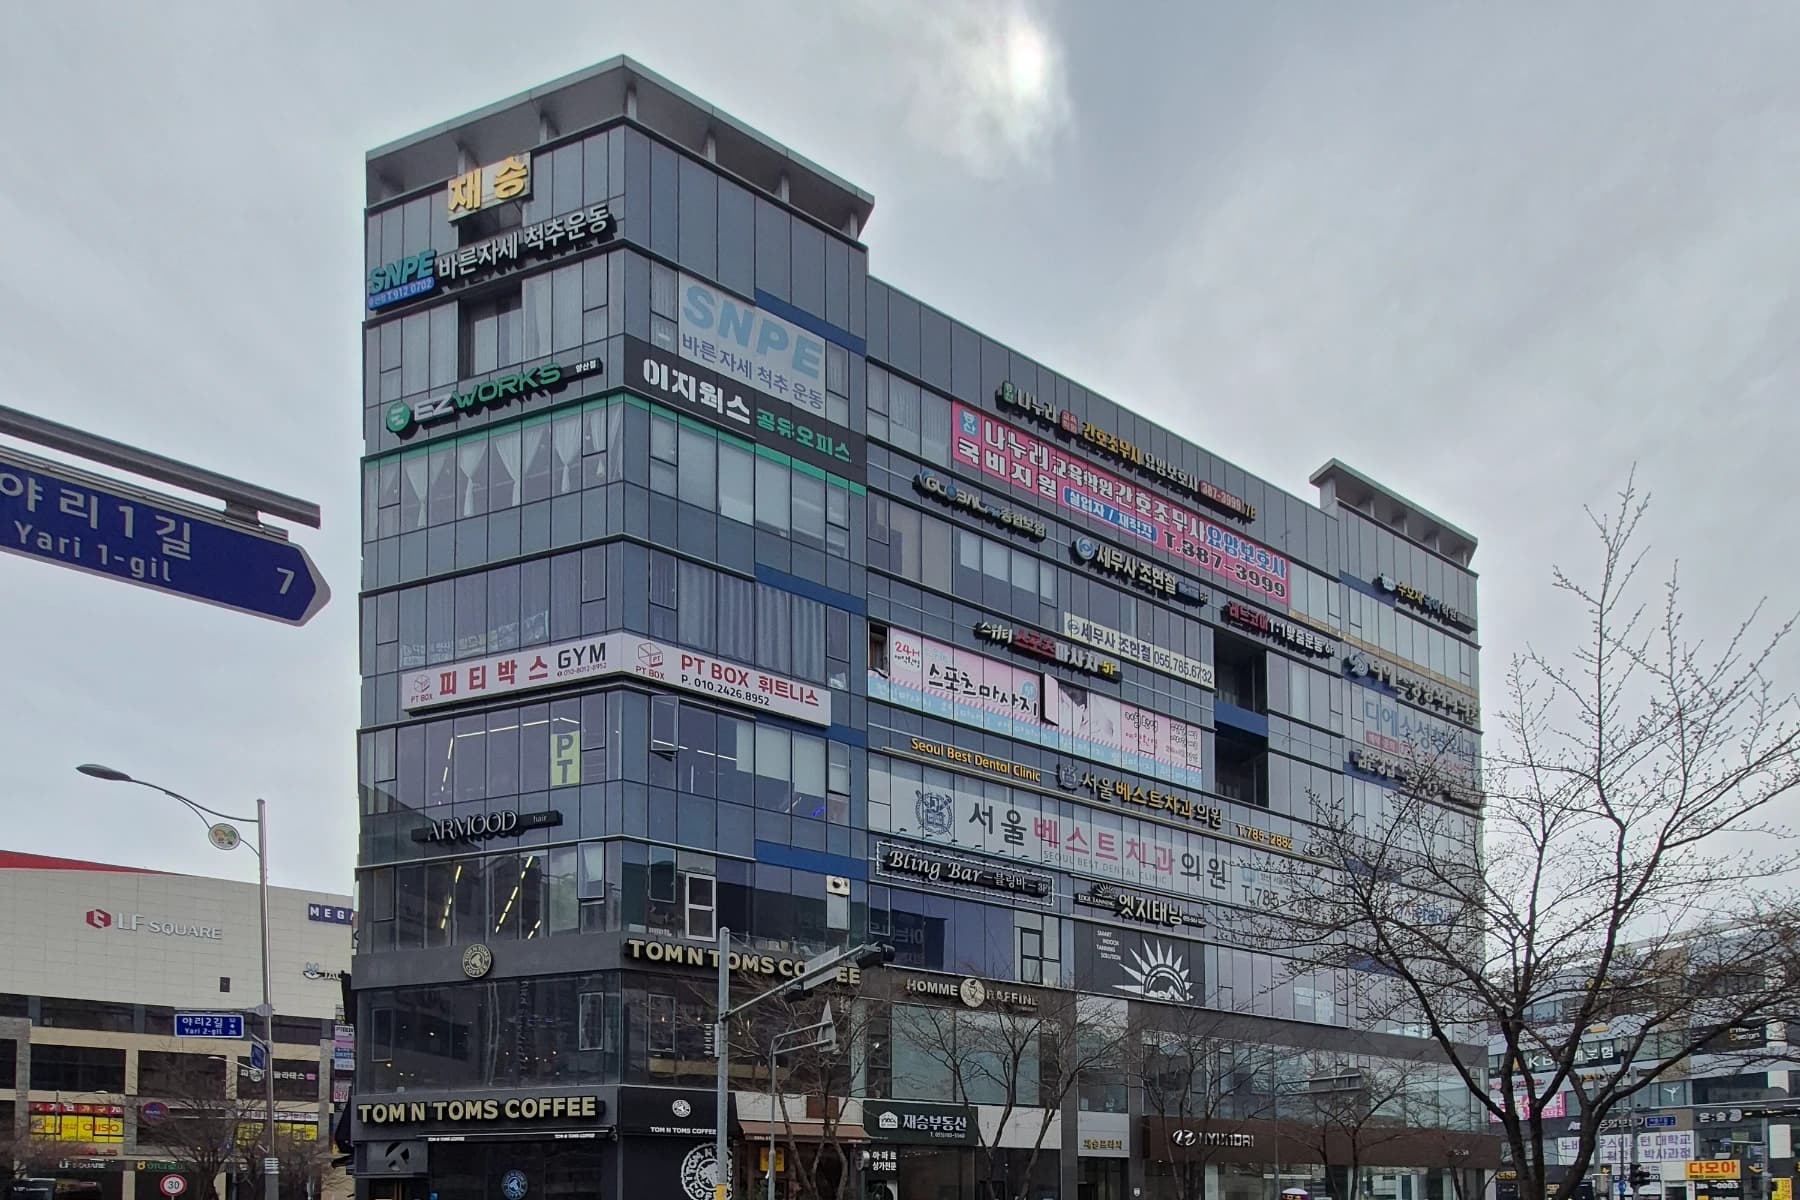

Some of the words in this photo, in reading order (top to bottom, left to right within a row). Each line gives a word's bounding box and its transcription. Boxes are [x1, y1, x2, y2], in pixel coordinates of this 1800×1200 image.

[449, 154, 530, 212] 재승
[438, 231, 519, 280] 바른자세
[524, 207, 609, 252] 척추운동
[369, 250, 435, 294] SNPE
[682, 284, 824, 380] SNPE
[413, 363, 562, 423] EZWORKS
[643, 358, 751, 425] 이지웍스
[756, 408, 852, 463] 공유오피스
[1018, 389, 1057, 424] 나누리
[1083, 420, 1142, 465] 간호조무사
[958, 436, 1059, 502] 국비지원
[0, 472, 191, 561] 야리1길
[14, 520, 81, 558] Yari
[97, 544, 171, 583] 1-gil
[1097, 547, 1137, 578] 세무사
[1206, 525, 1287, 580] 요양보호사
[276, 567, 295, 595] 7
[440, 655, 548, 695] 피티박스
[558, 641, 607, 670] GYM
[635, 665, 647, 676] PT
[649, 669, 665, 680] BOX
[1055, 641, 1099, 673] 마사지
[1081, 622, 1116, 649] 세무사
[1152, 651, 1213, 684] 055.785.6732
[681, 654, 705, 675] PT
[711, 662, 749, 688] BOX
[758, 674, 819, 707] 휘트니스
[694, 677, 770, 707] 010.2426.8952
[928, 662, 1040, 719] 스포츠마사지
[911, 738, 944, 757] Seoul
[947, 745, 972, 764] Best
[974, 754, 1009, 774] Dental
[1013, 764, 1041, 783] Clinic
[533, 815, 547, 823] hair
[1083, 772, 1224, 830] 서울베스트치과의원
[889, 849, 943, 881] Bling
[947, 860, 985, 883] Bar
[117, 911, 145, 932] LF
[148, 919, 223, 941] SQUARE
[309, 903, 353, 920] MEG
[628, 938, 683, 964] TOM
[687, 947, 703, 967] N
[707, 948, 774, 975] TOMS
[778, 959, 862, 986] COEE
[907, 978, 959, 998] HOMME
[182, 1017, 224, 1029] 야리2길
[202, 1027, 223, 1036] 2-gil
[358, 1103, 405, 1123] TOM
[410, 1102, 426, 1122] N
[433, 1099, 499, 1121] TOMS
[504, 1096, 596, 1119] COFFEE
[650, 1126, 665, 1134] TOM
[673, 1127, 691, 1135] TOMS
[692, 1128, 717, 1136] COFFEE
[902, 1114, 967, 1131] 재승부동산
[168, 1180, 180, 1190] 30
[1689, 1161, 1737, 1174] 다모아
